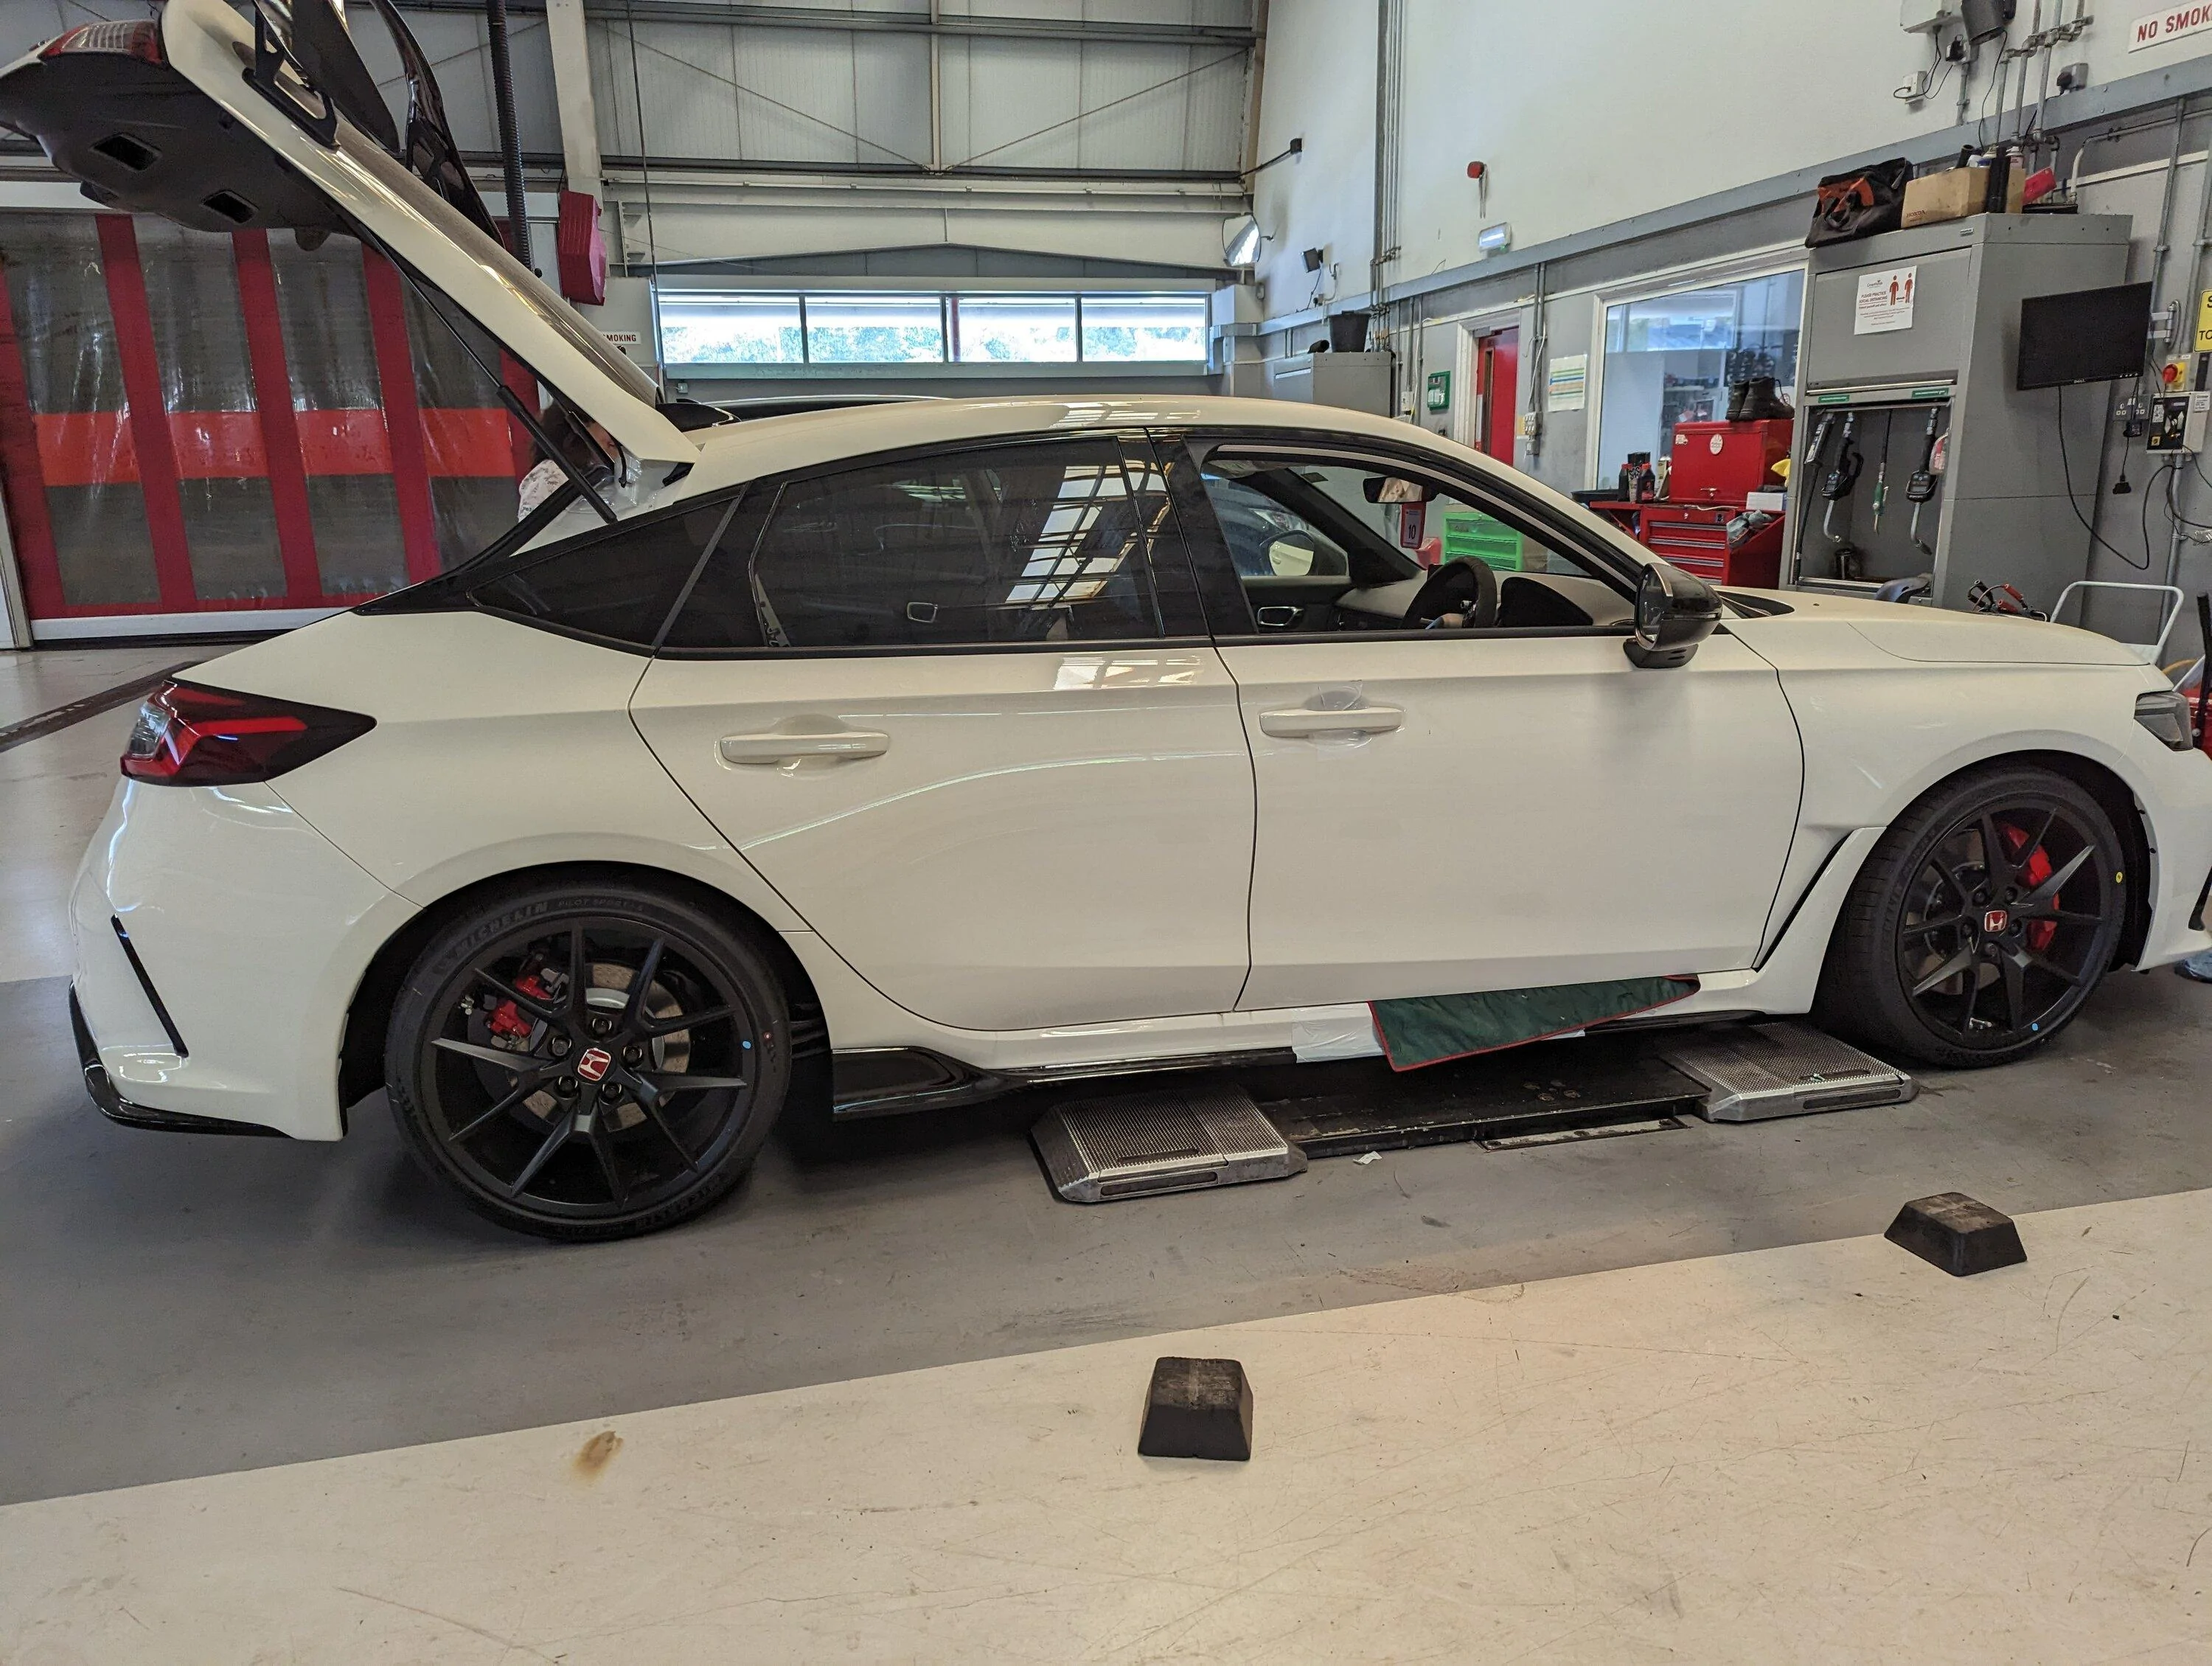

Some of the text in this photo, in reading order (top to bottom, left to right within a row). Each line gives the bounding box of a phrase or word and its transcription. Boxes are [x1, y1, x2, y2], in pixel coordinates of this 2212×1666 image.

[2138, 4, 2212, 42] NO SMOK
[1906, 209, 1926, 218] HONDA
[603, 334, 636, 342] MOKING
[1408, 524, 1416, 540] 10
